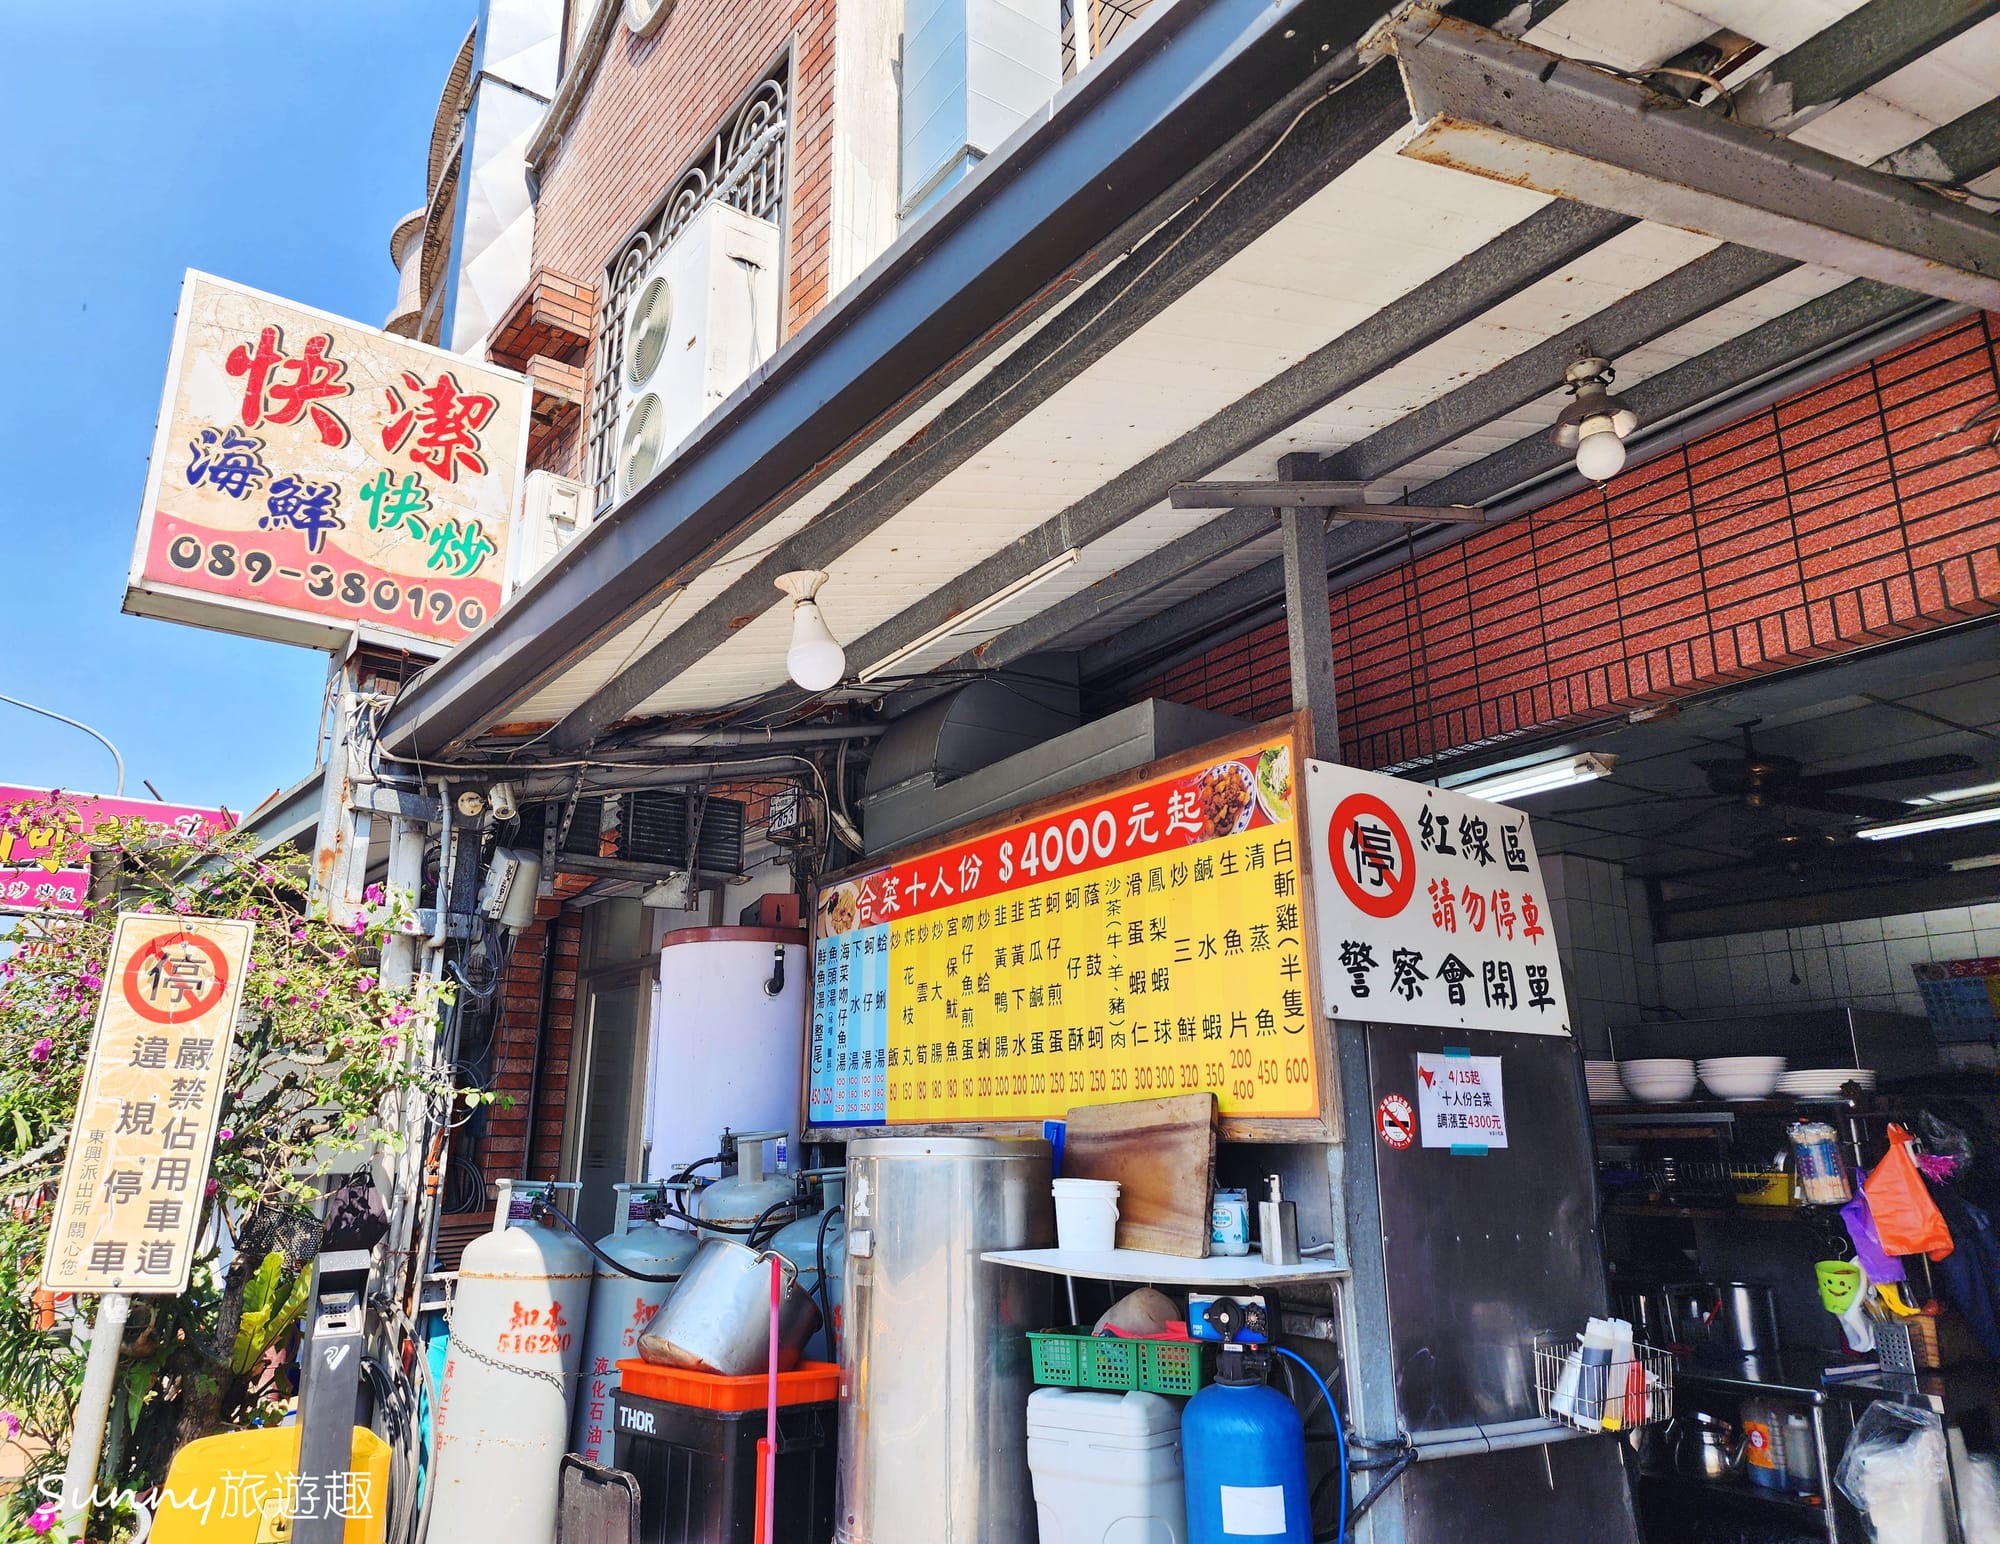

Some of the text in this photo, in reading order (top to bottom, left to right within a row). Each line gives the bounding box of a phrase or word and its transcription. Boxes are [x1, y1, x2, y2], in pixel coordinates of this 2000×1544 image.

[225, 325, 499, 482] 快潔
[186, 425, 497, 577] 海鮮 快炒
[169, 535, 487, 630] 089-380190
[1417, 803, 1530, 873] 紅線區
[856, 790, 1204, 922] 合菜十人份 $4000元起
[1350, 820, 1395, 888] 停
[1427, 878, 1545, 946] 請勿停車
[1170, 861, 1197, 1043] 炒三鮮
[1219, 850, 1249, 1039] 生魚片
[1245, 843, 1277, 1037] 清蒸魚
[1125, 872, 1149, 1047] 滑蛋蝦仁
[1147, 867, 1173, 1045] 鳳梨蝦球
[147, 954, 206, 1003] 停
[1338, 940, 1557, 1014] 警察會開單
[1230, 1048, 1252, 1069] 200
[1285, 1057, 1309, 1084] 600
[1030, 1073, 1045, 1094] 200
[1050, 1071, 1065, 1093] 250
[1069, 1070, 1085, 1093] 250
[1090, 1069, 1106, 1092] 250
[1111, 1068, 1128, 1091] 250
[1135, 1066, 1153, 1090] 300
[1156, 1065, 1175, 1089] 300
[1180, 1063, 1199, 1088] 320
[1206, 1062, 1225, 1087] 350
[1258, 1059, 1278, 1085] 450
[1449, 1070, 1481, 1086] 4/15起
[889, 1083, 898, 1101] 80
[902, 1082, 912, 1100] 150
[917, 1081, 927, 1100] 180
[931, 1080, 942, 1099] 180
[946, 1079, 958, 1098] 180
[962, 1078, 974, 1097] 180
[978, 1076, 992, 1096] 200
[994, 1075, 1009, 1095] 200
[1012, 1074, 1027, 1095] 200
[1233, 1079, 1254, 1099] 400
[1442, 1091, 1493, 1107] 十人份合菜
[1437, 1114, 1501, 1130] 調漲至4300元
[87, 1036, 170, 1275] 違規停車
[135, 1037, 215, 1275] 嚴禁佔用車道
[509, 1301, 566, 1332] 知本
[497, 1333, 571, 1354] 516280
